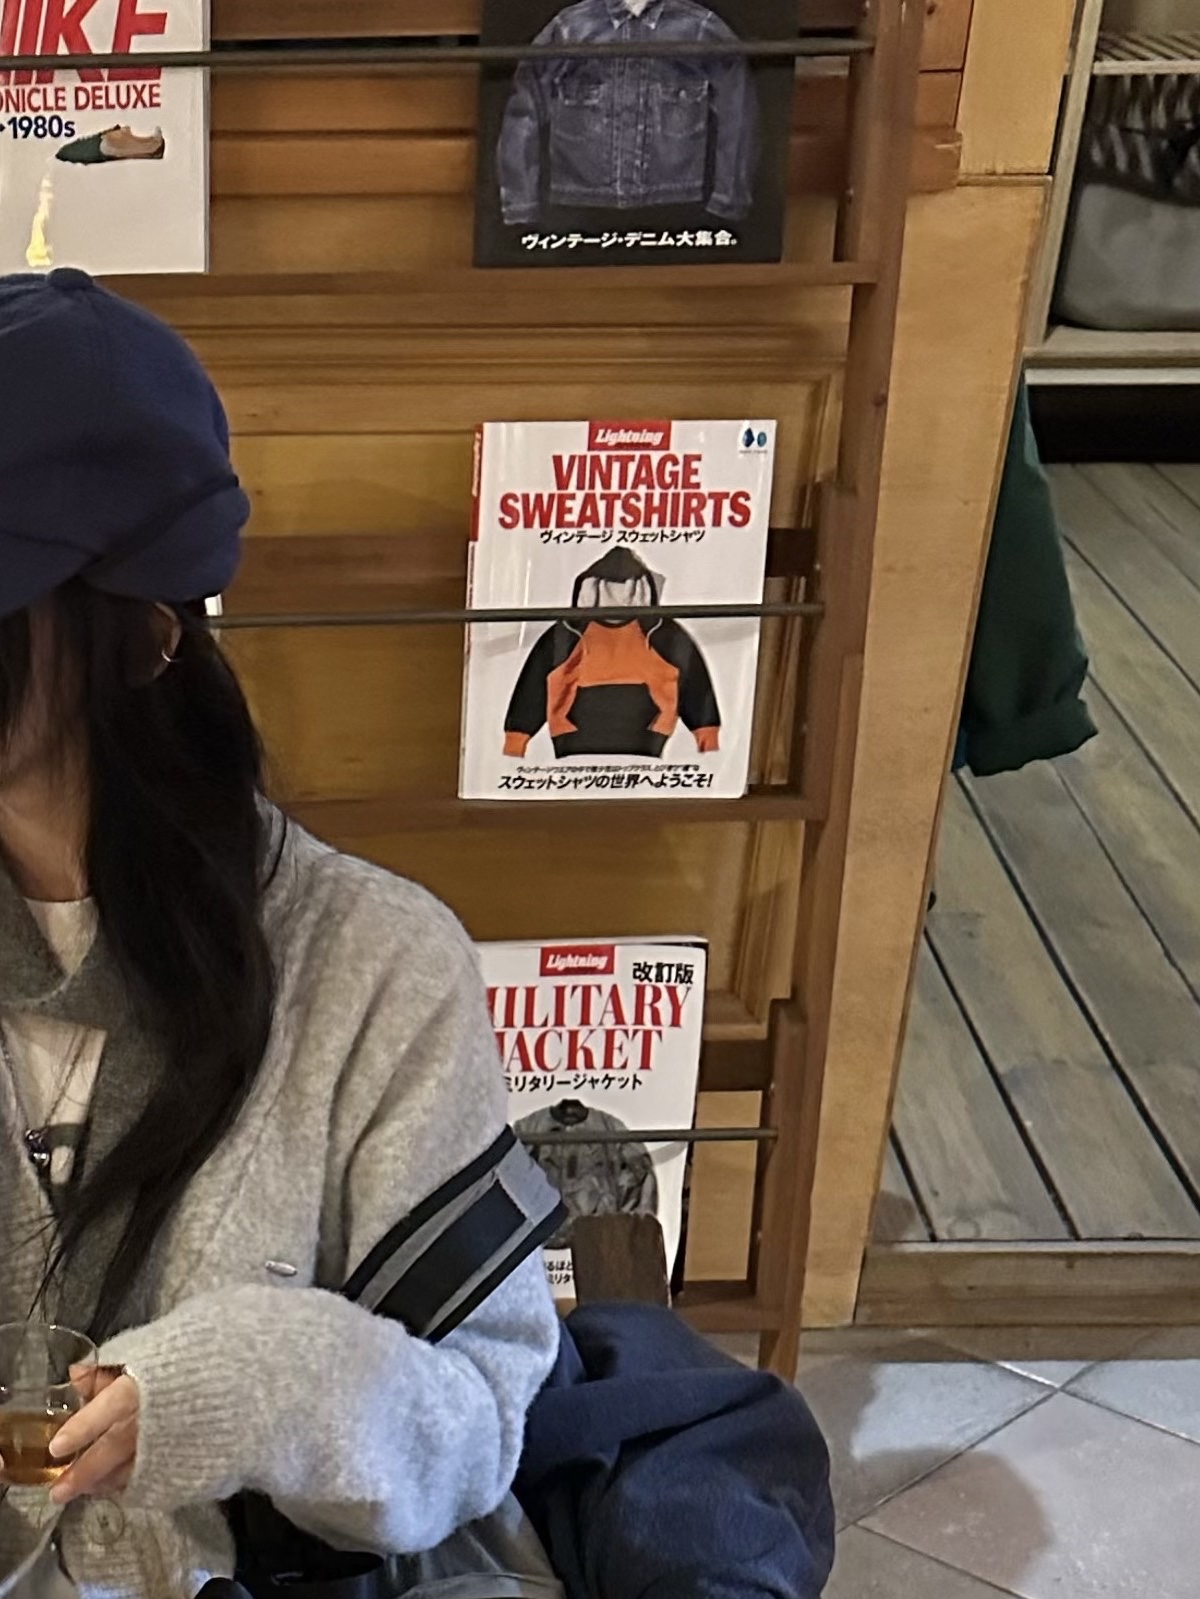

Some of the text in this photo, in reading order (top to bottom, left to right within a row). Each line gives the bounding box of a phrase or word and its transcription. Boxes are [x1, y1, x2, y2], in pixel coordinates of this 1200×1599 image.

[74, 83, 161, 110] DELUXE
[595, 428, 664, 446] Lightning
[553, 453, 702, 490] VINTAGE
[498, 490, 751, 529] SWEATSHIRTS
[540, 529, 705, 544] ヴィンテージ スウェットシャツ
[546, 953, 608, 971] Lightning
[633, 961, 694, 984] 改訂版
